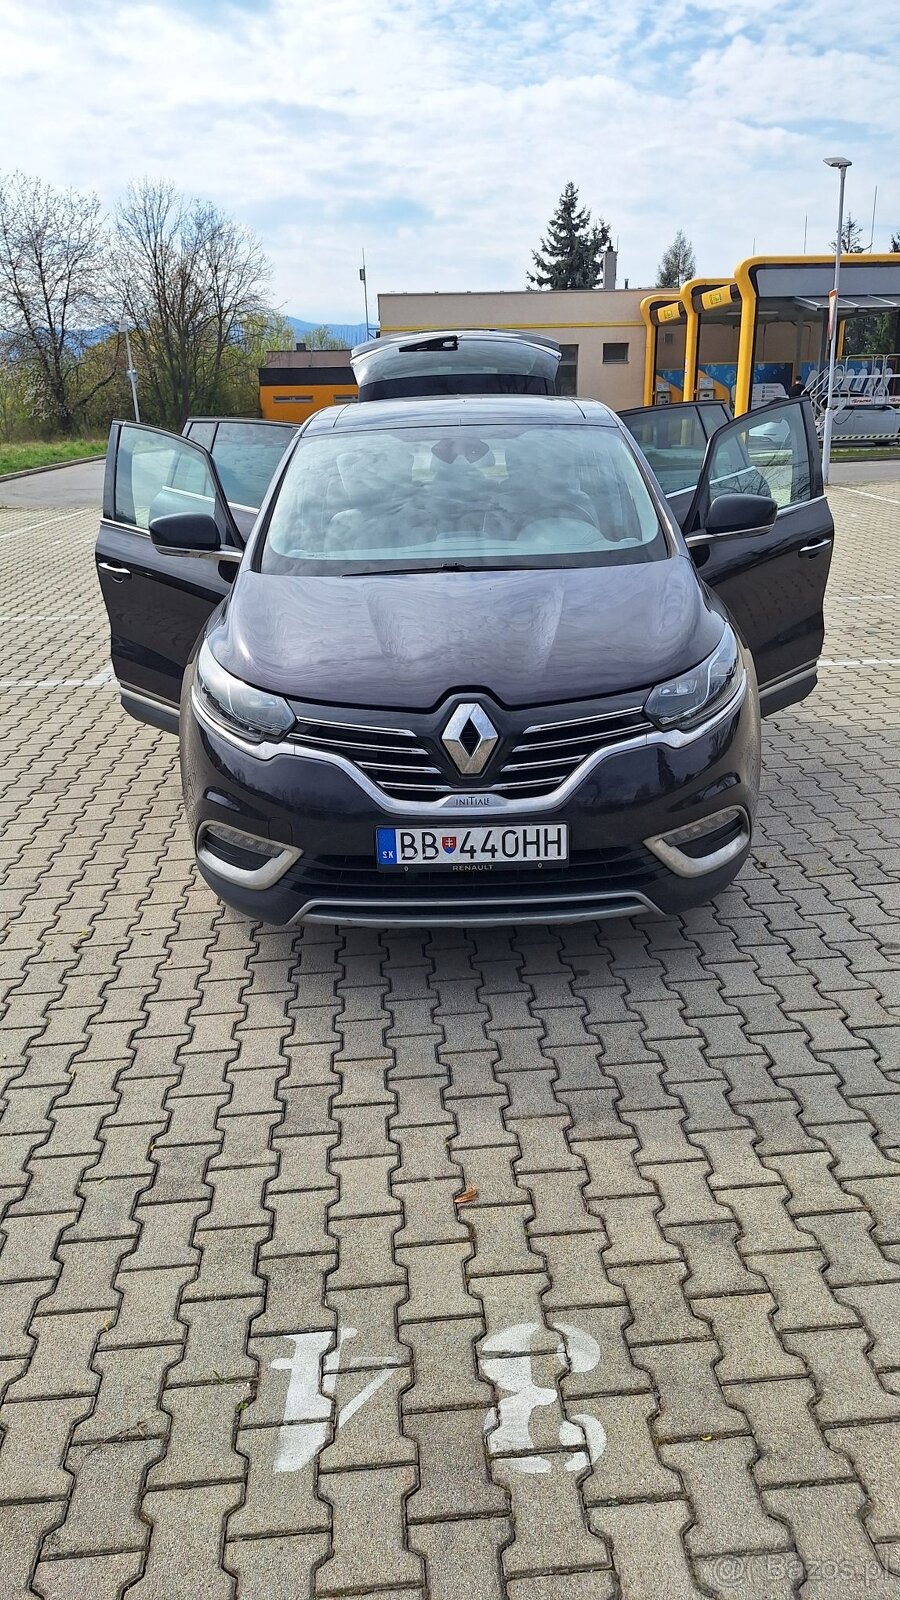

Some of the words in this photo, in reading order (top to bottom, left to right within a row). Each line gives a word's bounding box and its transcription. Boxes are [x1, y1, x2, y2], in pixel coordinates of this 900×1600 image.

[382, 850, 394, 859] SK
[400, 831, 439, 860] BB
[459, 829, 562, 859] 440HH
